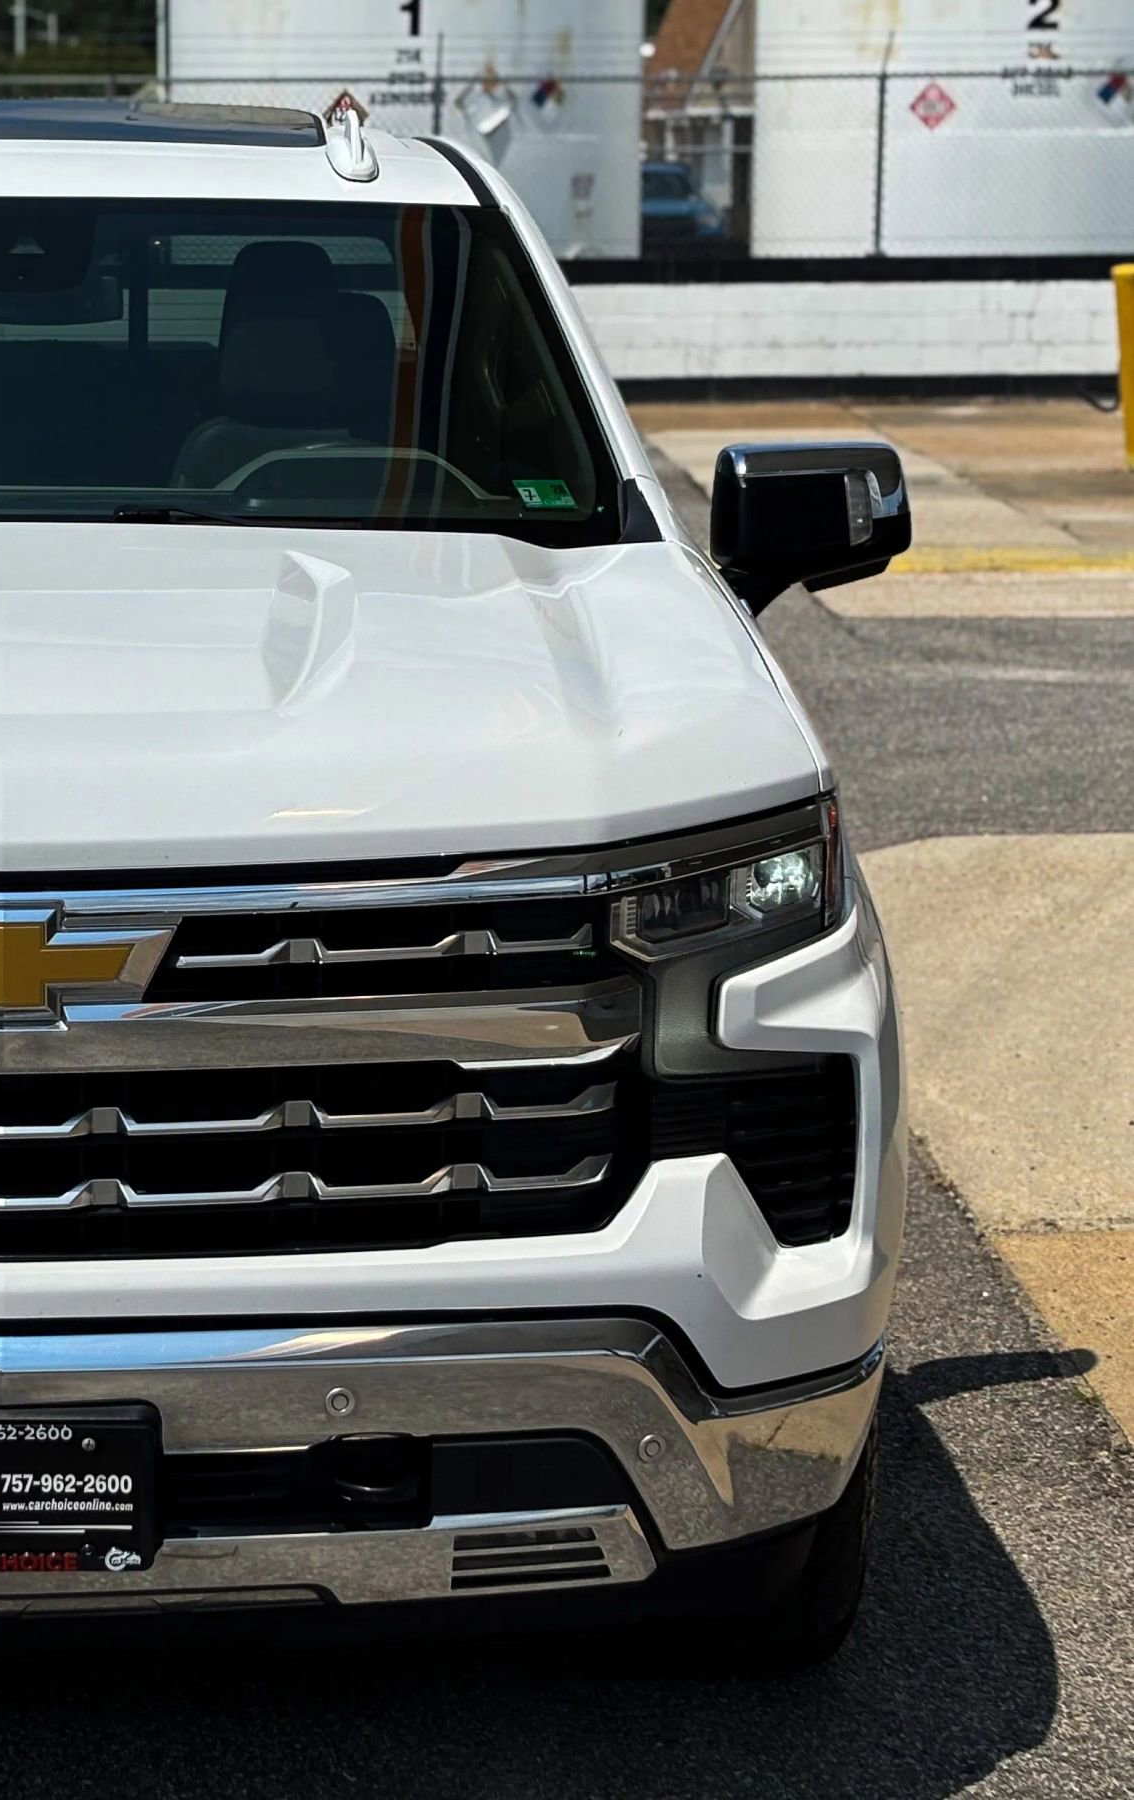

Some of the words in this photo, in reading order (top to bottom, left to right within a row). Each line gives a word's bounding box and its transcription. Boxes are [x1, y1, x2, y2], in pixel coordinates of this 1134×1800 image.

[399, 0, 421, 36] 1
[1027, 0, 1060, 30] 2
[0, 1474, 132, 1494] 757-962-2600
[2, 1498, 133, 1512] www.carchoiceonline.com
